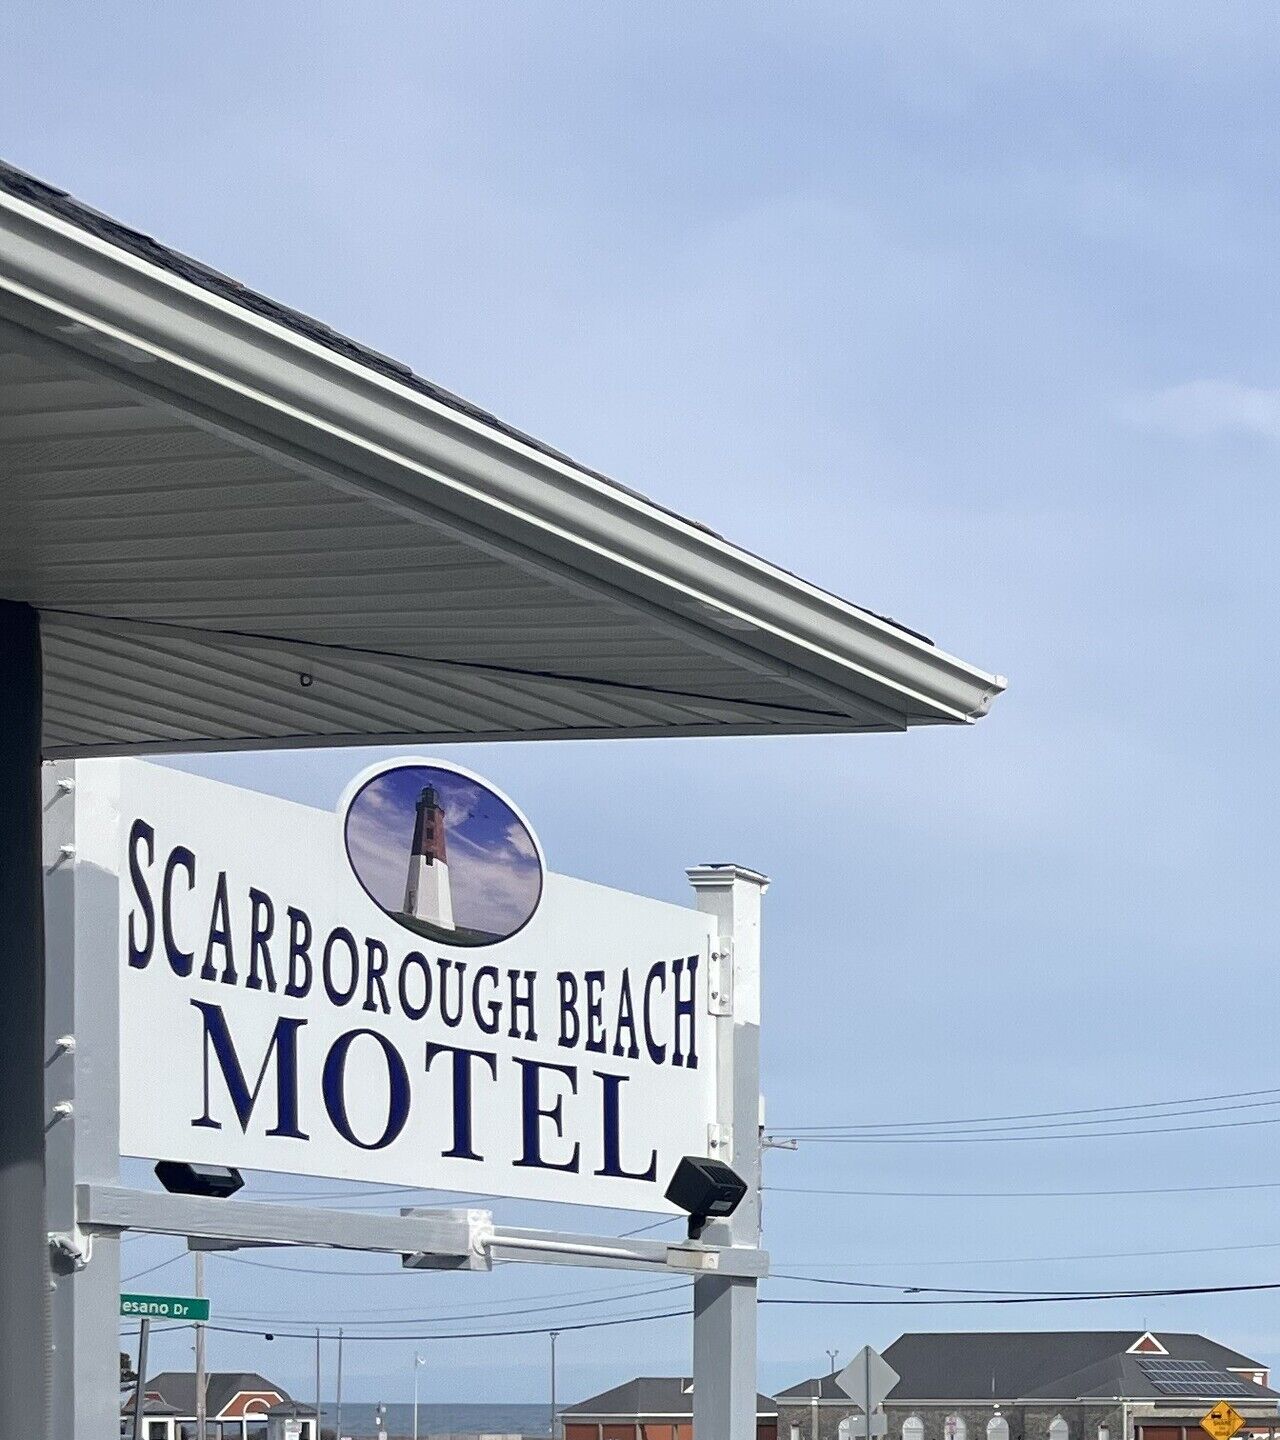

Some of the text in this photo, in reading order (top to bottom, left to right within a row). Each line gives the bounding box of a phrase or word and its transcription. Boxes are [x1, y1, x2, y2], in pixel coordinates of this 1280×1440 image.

[127, 818, 700, 1070] SCARBOROUGH BEACH
[190, 998, 658, 1184] MOTEL
[122, 1301, 189, 1316] esano Dr
